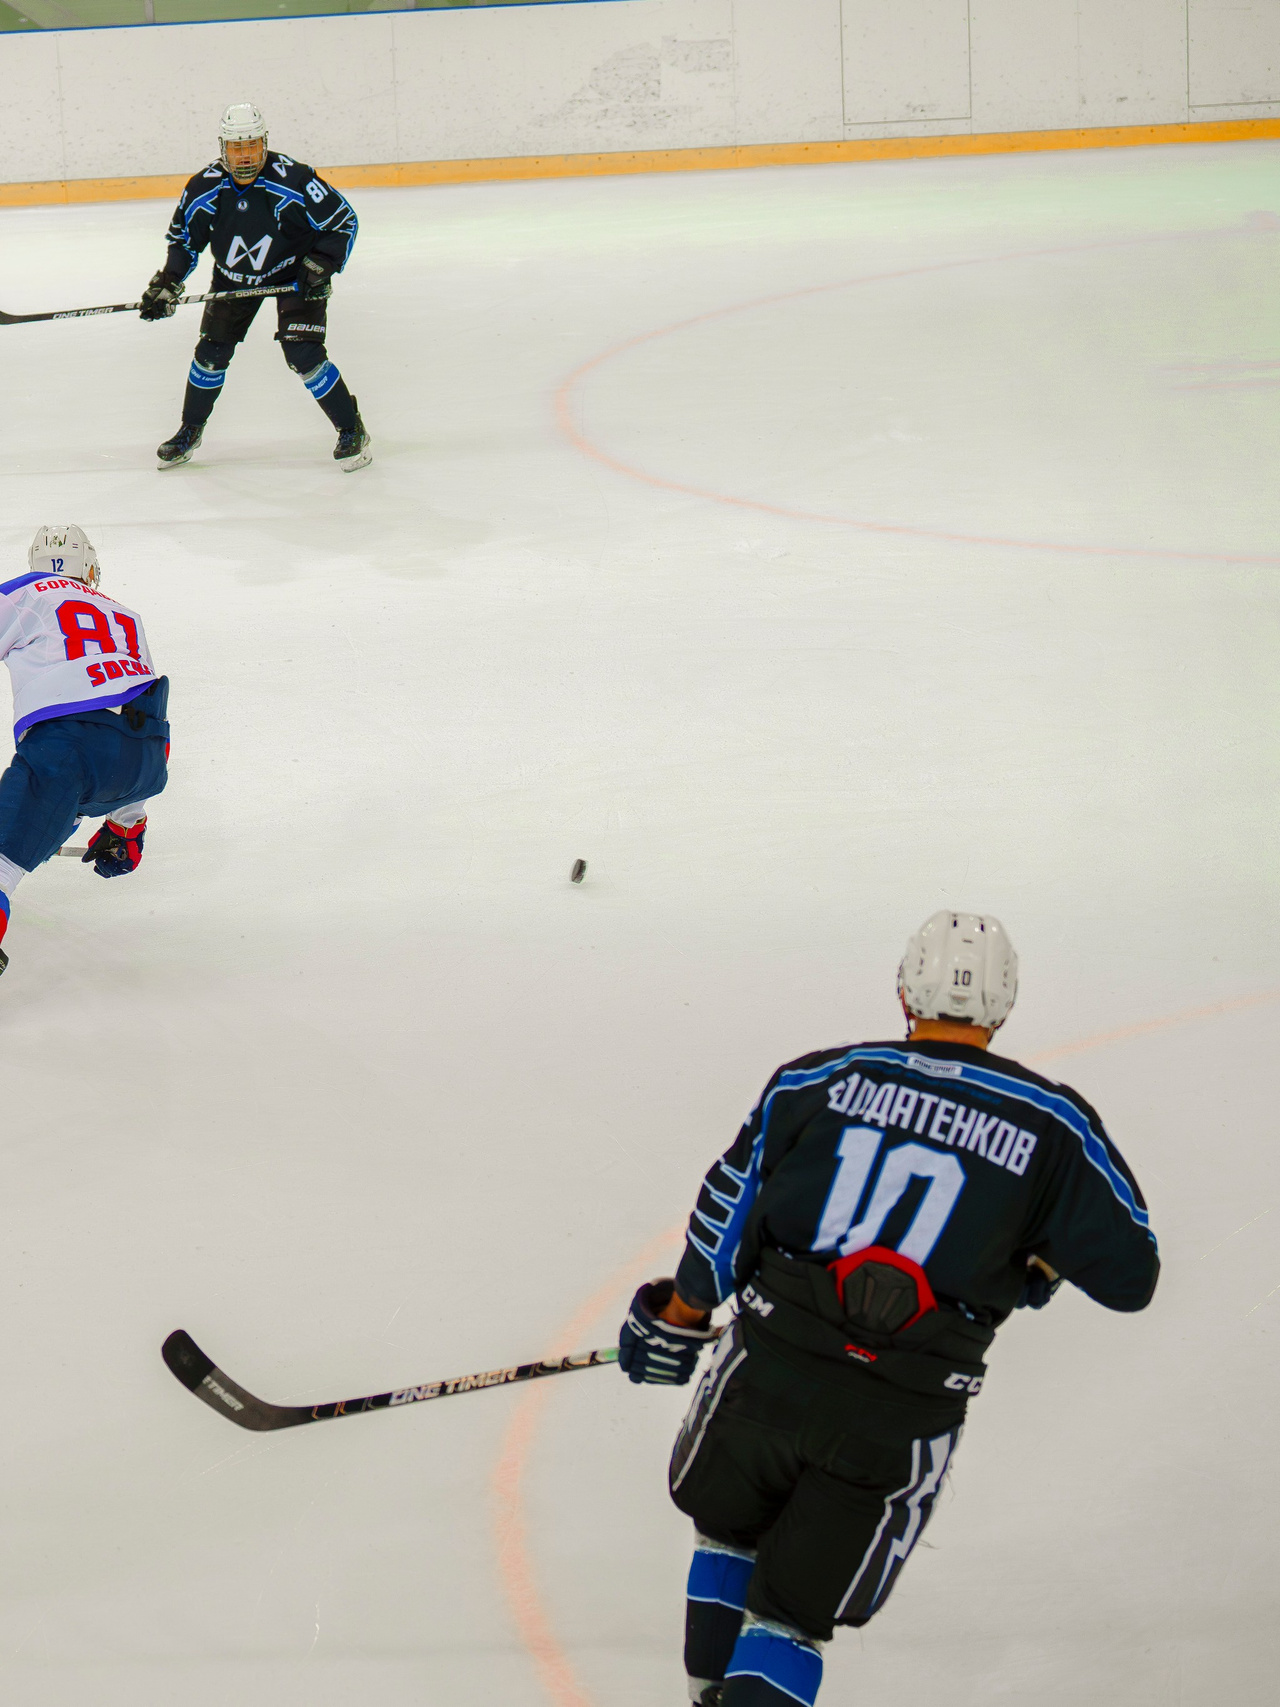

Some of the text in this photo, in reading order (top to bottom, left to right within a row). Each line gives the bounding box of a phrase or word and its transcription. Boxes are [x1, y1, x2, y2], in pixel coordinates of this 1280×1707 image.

[306, 178, 329, 204] 81
[216, 263, 243, 283] NE
[50, 558, 64, 573] 12
[55, 600, 141, 661] 81
[952, 969, 972, 987] 10
[810, 1125, 968, 1268] 10
[388, 1367, 519, 1406] ONE TIMER
